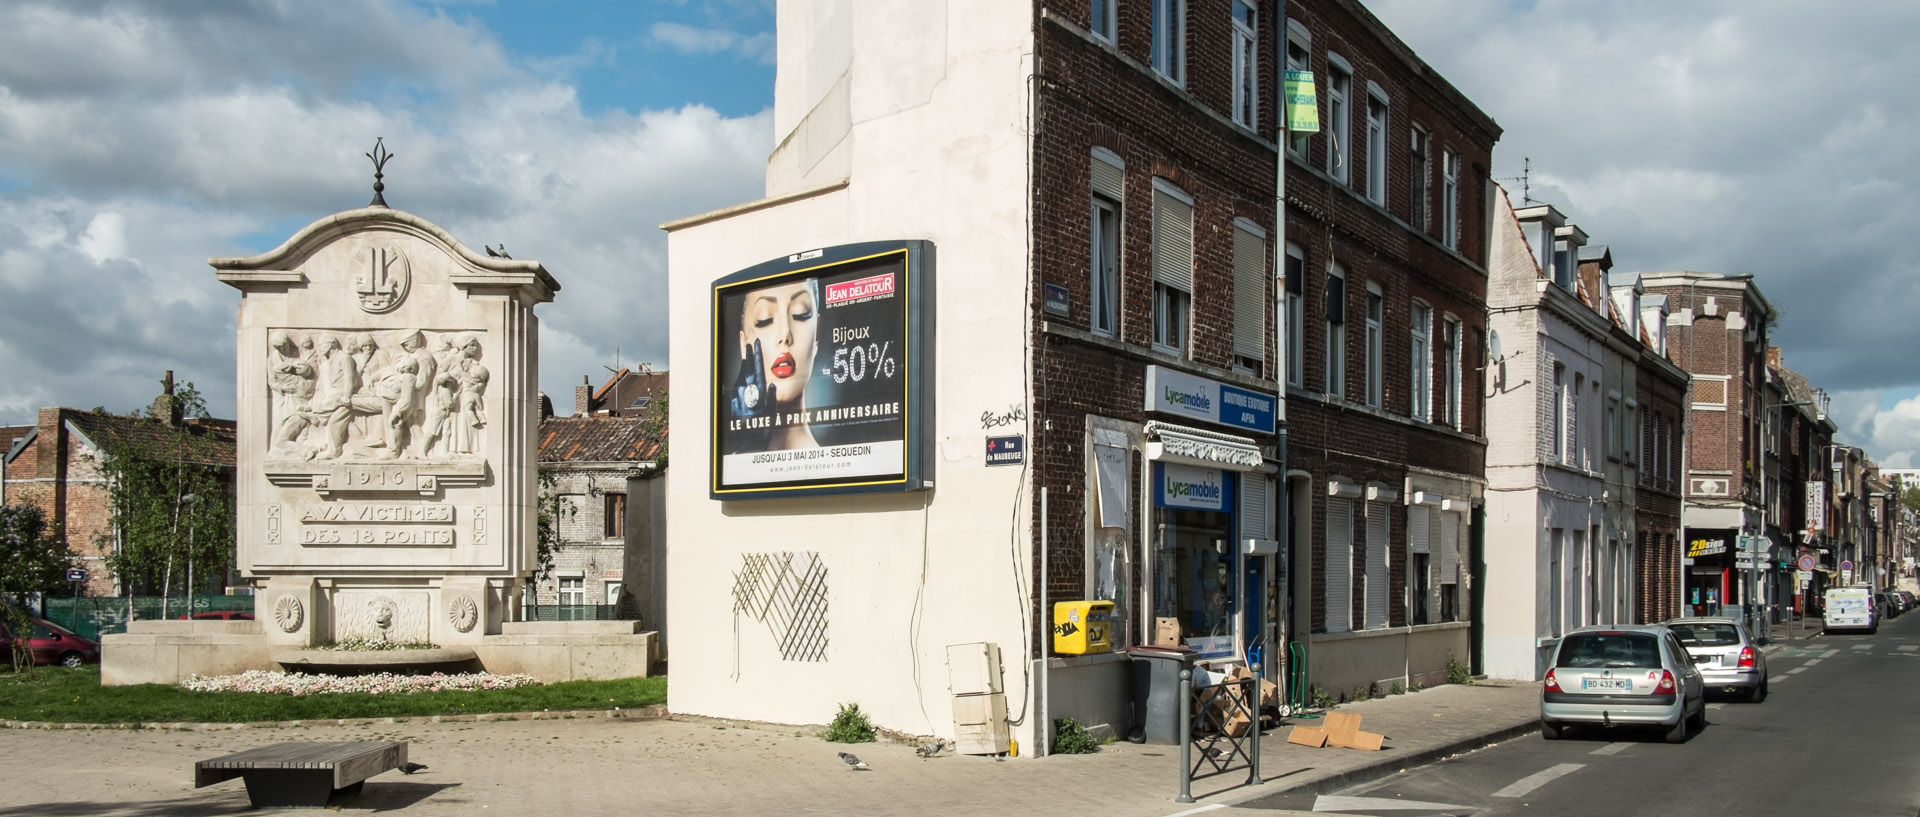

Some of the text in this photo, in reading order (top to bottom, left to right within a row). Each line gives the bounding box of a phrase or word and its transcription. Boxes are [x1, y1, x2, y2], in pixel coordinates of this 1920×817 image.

[827, 288, 847, 301] JEAN
[849, 277, 892, 297] DELATOUR
[833, 326, 870, 345] Bijoux
[1165, 385, 1210, 410] Lycamobile
[1224, 391, 1270, 413] BOUTIQUE EXOTIQUE
[730, 420, 741, 431] LE
[746, 416, 771, 429] LUXE
[775, 413, 782, 426] À
[786, 412, 811, 425] PRIX
[816, 402, 899, 422] ANNIVERSAIRE
[1241, 412, 1256, 425] AFIA
[752, 450, 787, 464] JUSQU'AU
[788, 450, 792, 461] 3
[793, 449, 807, 461] MAI
[808, 448, 825, 459] 2014
[830, 446, 871, 458] SEQUEDIN
[994, 451, 1022, 461] MAUBEUGE
[770, 461, 852, 473] www.jean-delatour.com
[346, 470, 404, 486] 1916
[1167, 476, 1219, 498] Lycamobile
[354, 506, 449, 521] VICTIMES
[304, 529, 450, 544] DES 18 PONTS
[1648, 671, 1656, 680] A
